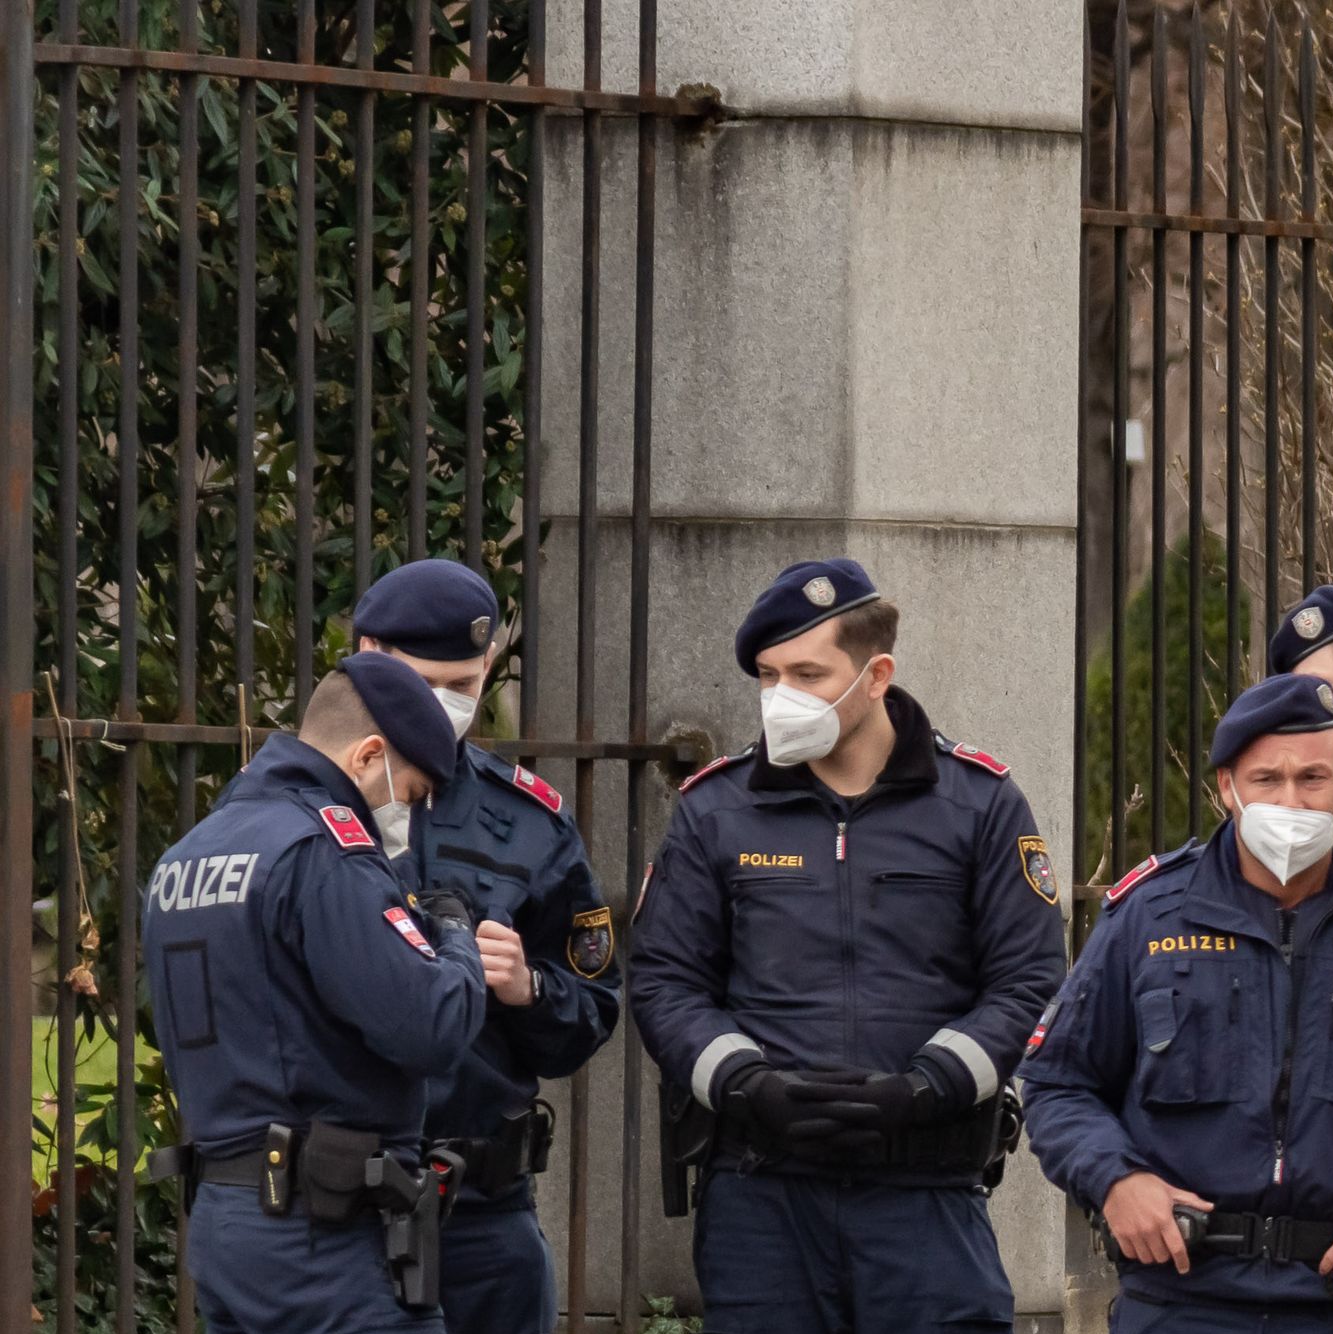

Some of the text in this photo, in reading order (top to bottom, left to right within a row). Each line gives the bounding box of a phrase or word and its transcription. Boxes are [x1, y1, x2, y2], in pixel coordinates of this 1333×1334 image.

[739, 853, 803, 867] POLIZEI
[147, 853, 260, 912] POLIZEI
[1148, 935, 1236, 956] POLIZEI
